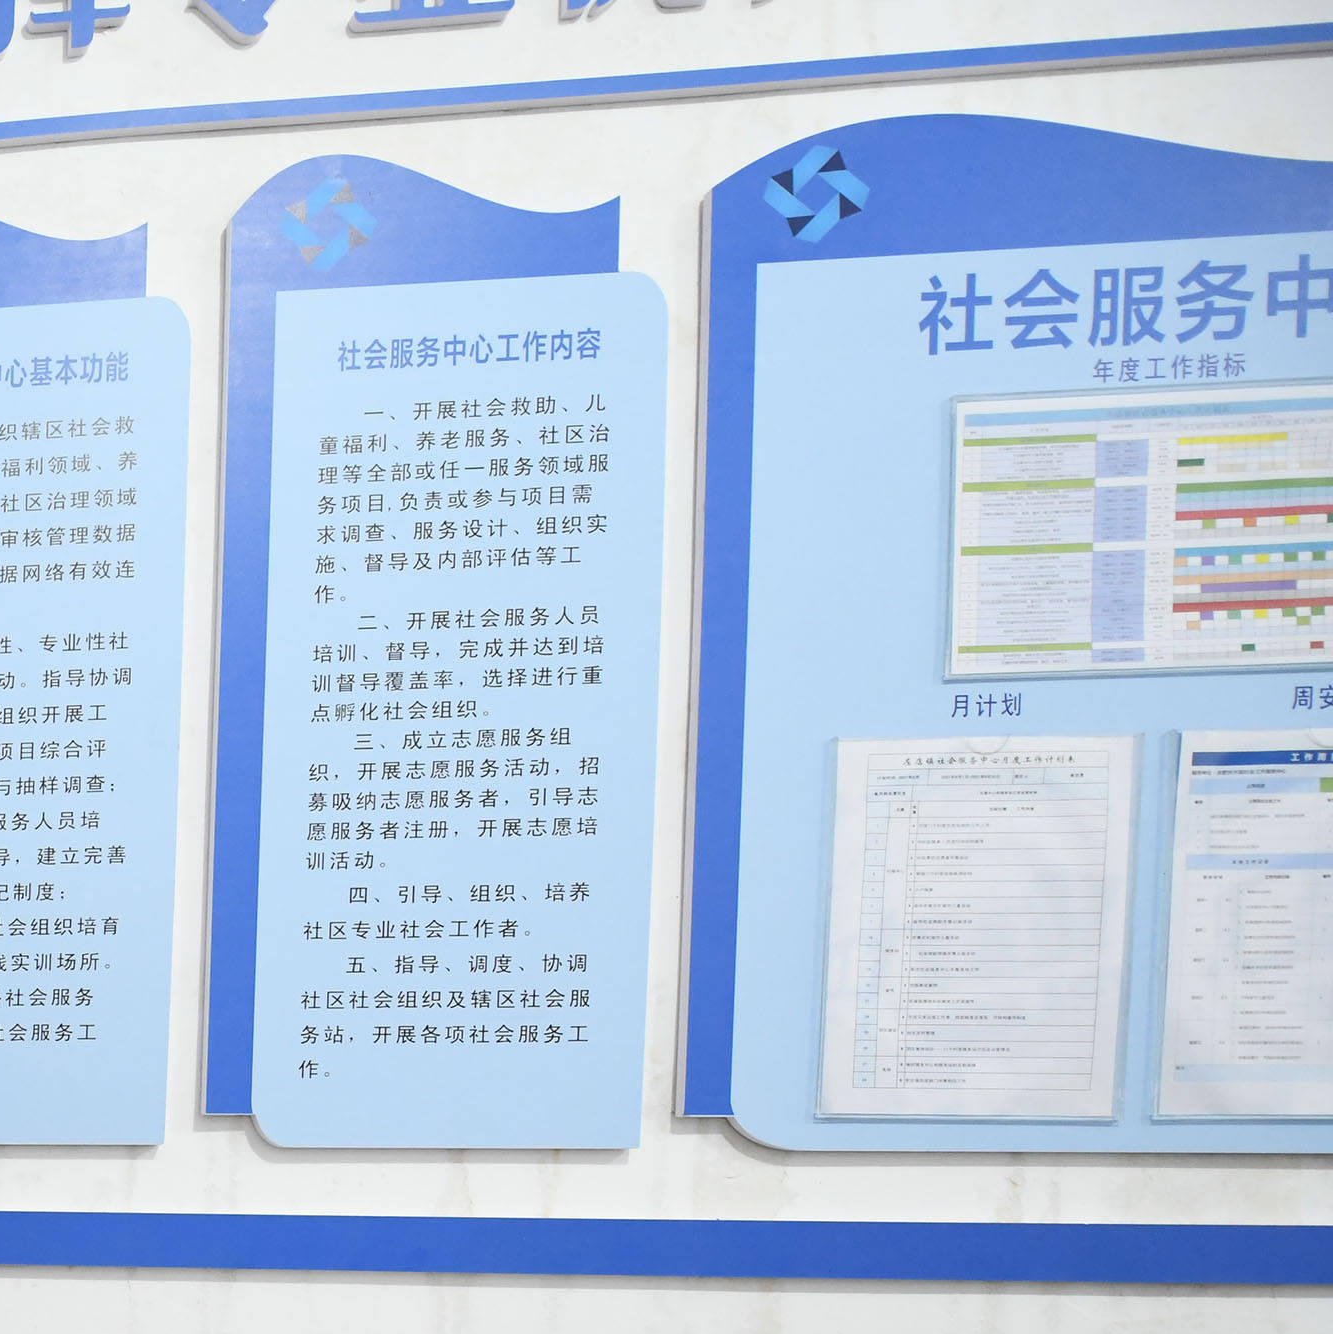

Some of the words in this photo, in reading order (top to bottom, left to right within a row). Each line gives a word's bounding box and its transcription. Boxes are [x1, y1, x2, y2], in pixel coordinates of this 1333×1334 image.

[919, 254, 1333, 356] 社会服务中
[338, 327, 601, 372] 社会服务中心工作内容
[1093, 352, 1247, 383] 年度工作指标
[363, 394, 606, 421] 一、开展社会救助、儿
[319, 423, 610, 456] 童福利、养老服务、社区治
[318, 454, 610, 485] 理等全部或任一服务领域服
[317, 514, 608, 544] 求调查、服务设计、组织实
[315, 546, 582, 575] 施、督导及内部评估等工
[314, 584, 348, 605] 作。
[358, 605, 601, 632] 二、开展社会服务人员
[313, 635, 604, 664] 培训、督导，完成并达到培
[312, 666, 604, 694] 训督导覆盖率，选择进行重
[310, 699, 491, 723] 点孵化社会组织。
[951, 692, 1023, 718] 月计划
[354, 727, 572, 752] 三、成立志愿服务组
[309, 756, 600, 782] 织，开展志愿服务活动，招
[308, 786, 599, 812] 募吸纳志愿服务者，引导志
[306, 816, 598, 841] 愿服务者注册，开展志愿培
[306, 851, 389, 871] 训活动。
[349, 881, 591, 905] 四、引导、组织、培养
[303, 918, 534, 941] 社区专业社会工作者。
[345, 953, 588, 975] 五、指导、调度、协调
[301, 988, 591, 1010] 社区社会组织及辖区社会服
[300, 1024, 589, 1045] 务站，开展各项社会服务工
[298, 1059, 332, 1080] 作。
